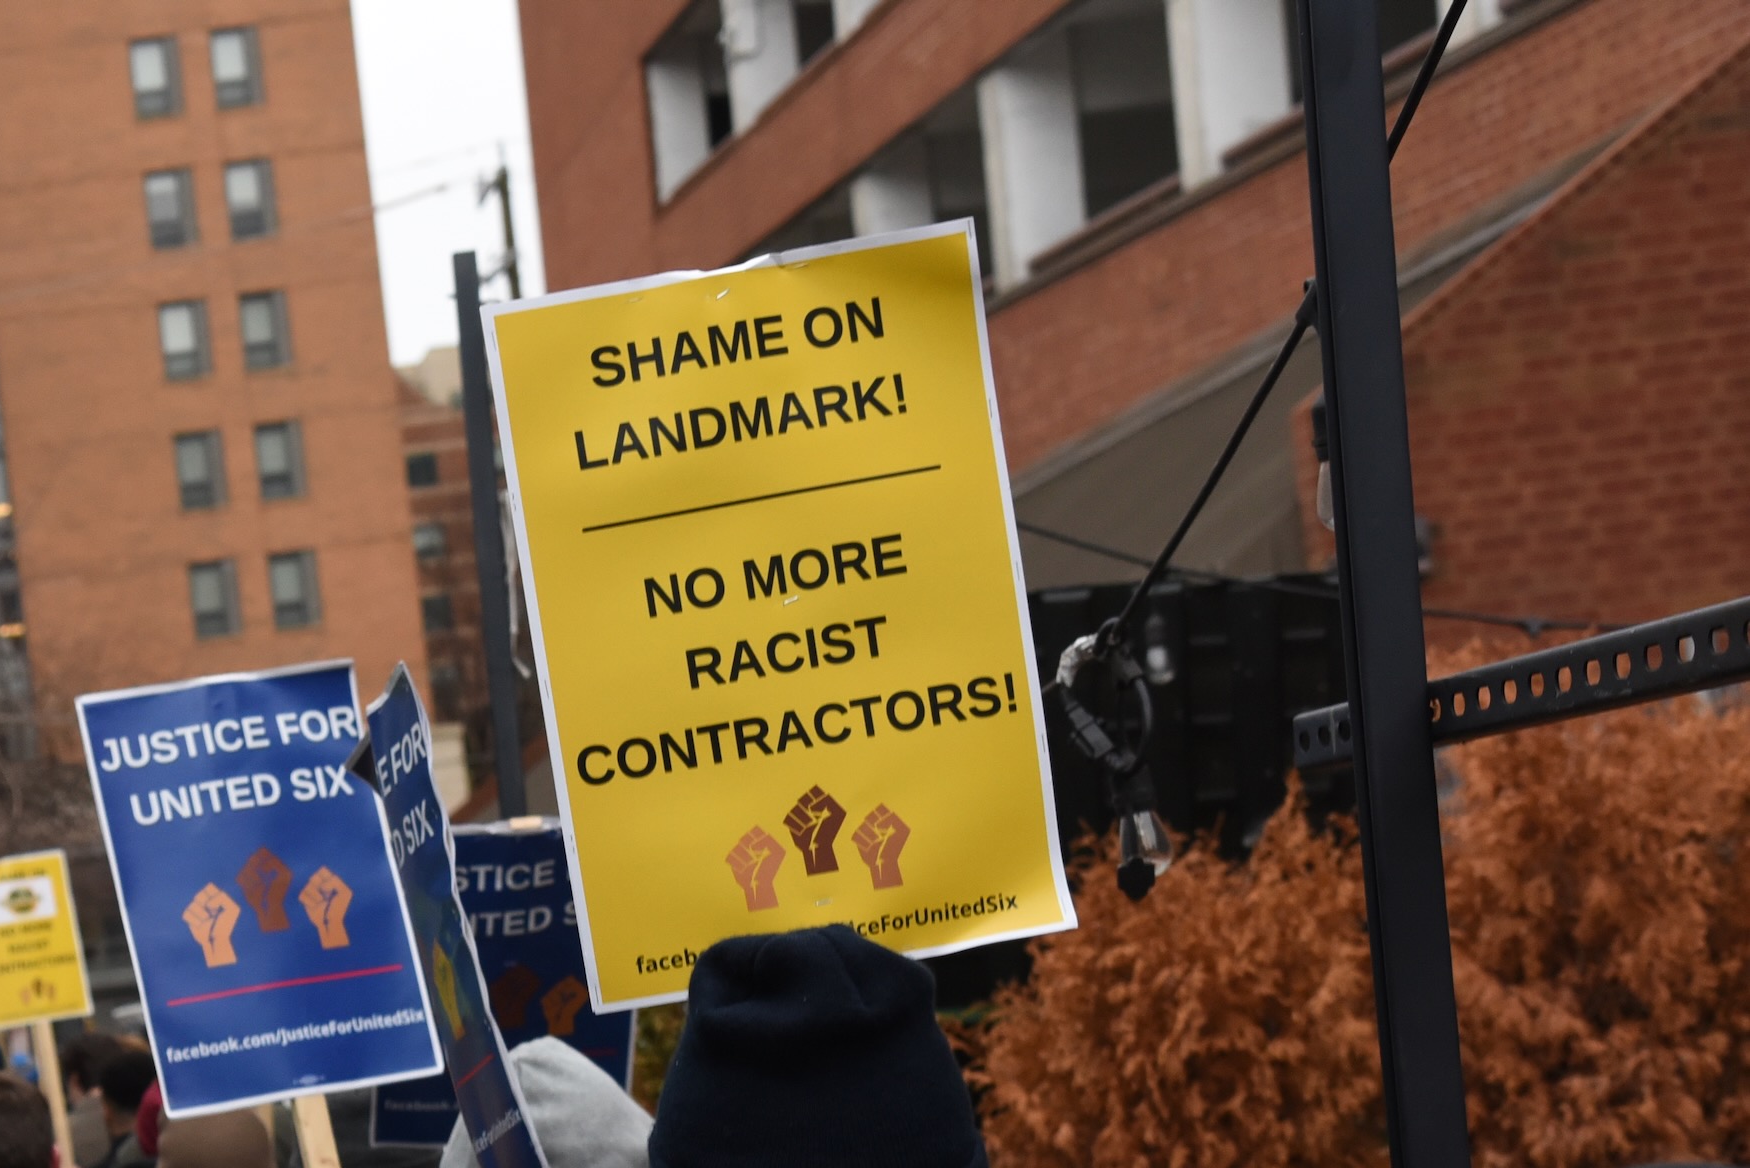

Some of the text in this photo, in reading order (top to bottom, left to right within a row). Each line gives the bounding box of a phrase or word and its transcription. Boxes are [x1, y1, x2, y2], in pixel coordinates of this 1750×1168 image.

[590, 296, 885, 388] SHAME ON
[574, 373, 908, 471] LANDMARK!
[644, 533, 908, 618] NO MORE
[686, 615, 888, 690] RACIST
[100, 706, 359, 772] JUSTICE FOR
[390, 722, 426, 785] FOR
[576, 672, 1018, 786] CONTRACTORS!
[130, 773, 281, 826] UNITED
[291, 764, 354, 802] SIX
[403, 799, 434, 855] SIX
[454, 859, 554, 892] STICE
[469, 906, 553, 937] ITED
